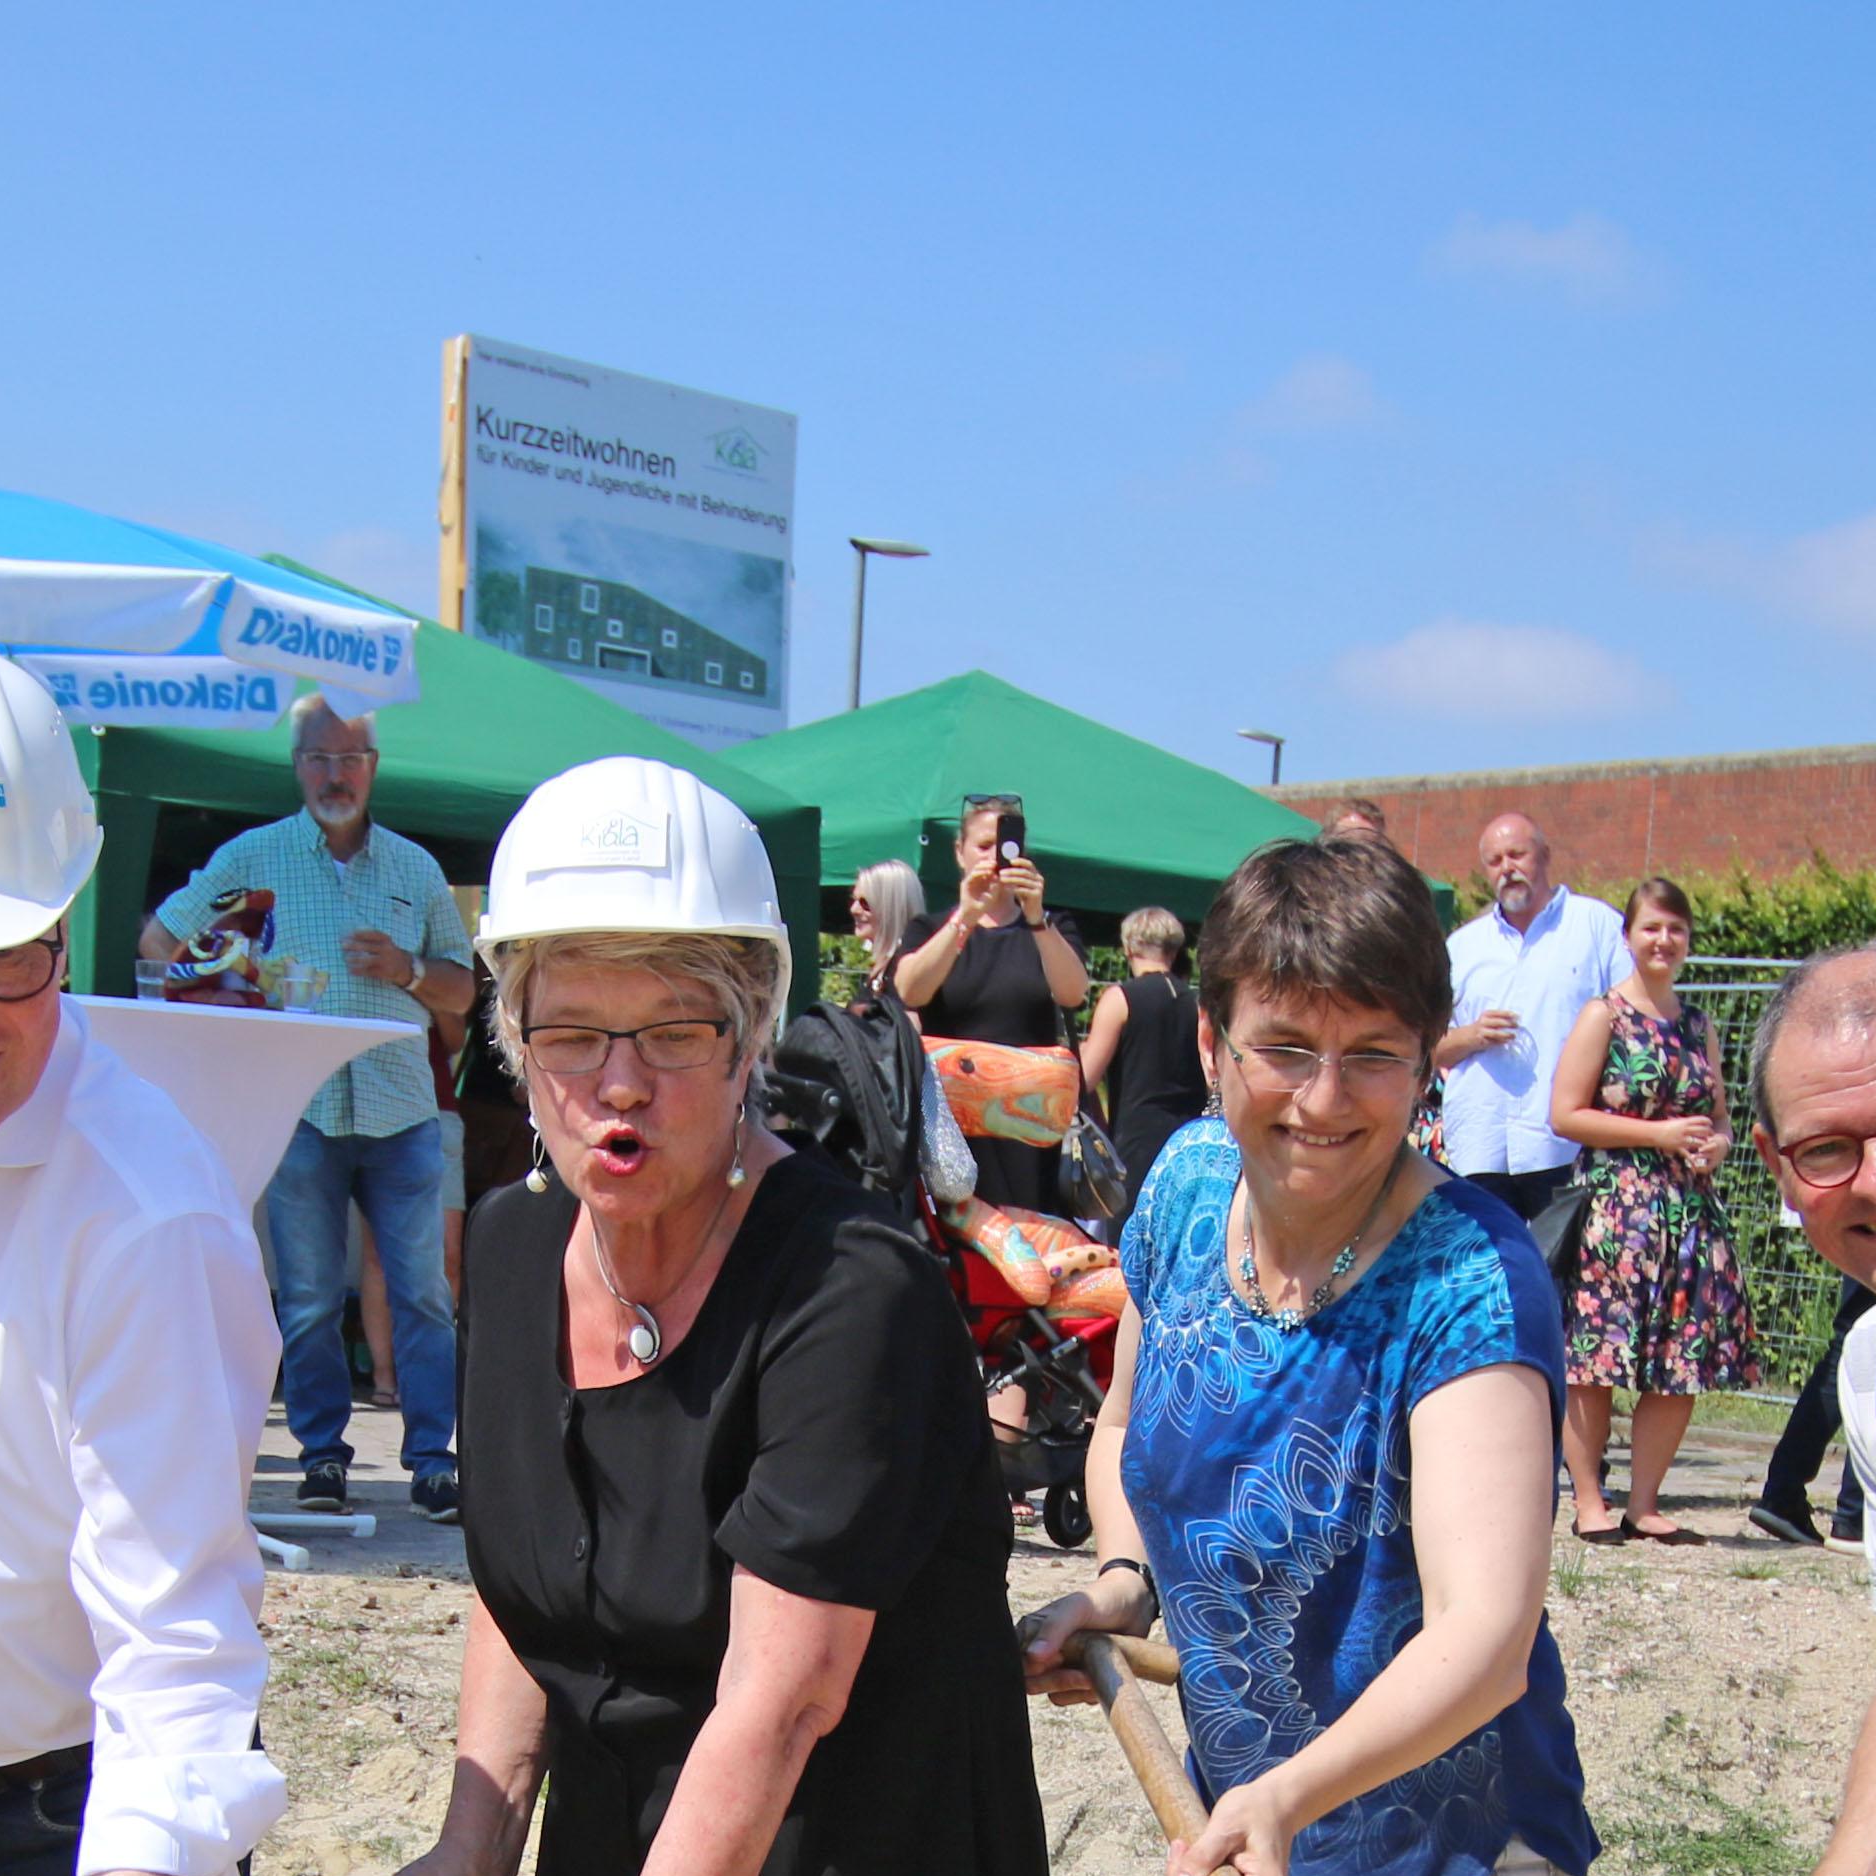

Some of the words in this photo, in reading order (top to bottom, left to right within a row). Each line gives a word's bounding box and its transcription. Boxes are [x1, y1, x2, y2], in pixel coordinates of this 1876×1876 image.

[476, 404, 676, 478] Kurzzeitwohnen
[476, 444, 498, 464] für
[501, 450, 550, 477] Kinder
[555, 465, 583, 484] und
[587, 472, 673, 505] Jugendliche
[676, 491, 698, 511] mit
[701, 495, 788, 534] Behinderung
[238, 606, 378, 672] Diakonie
